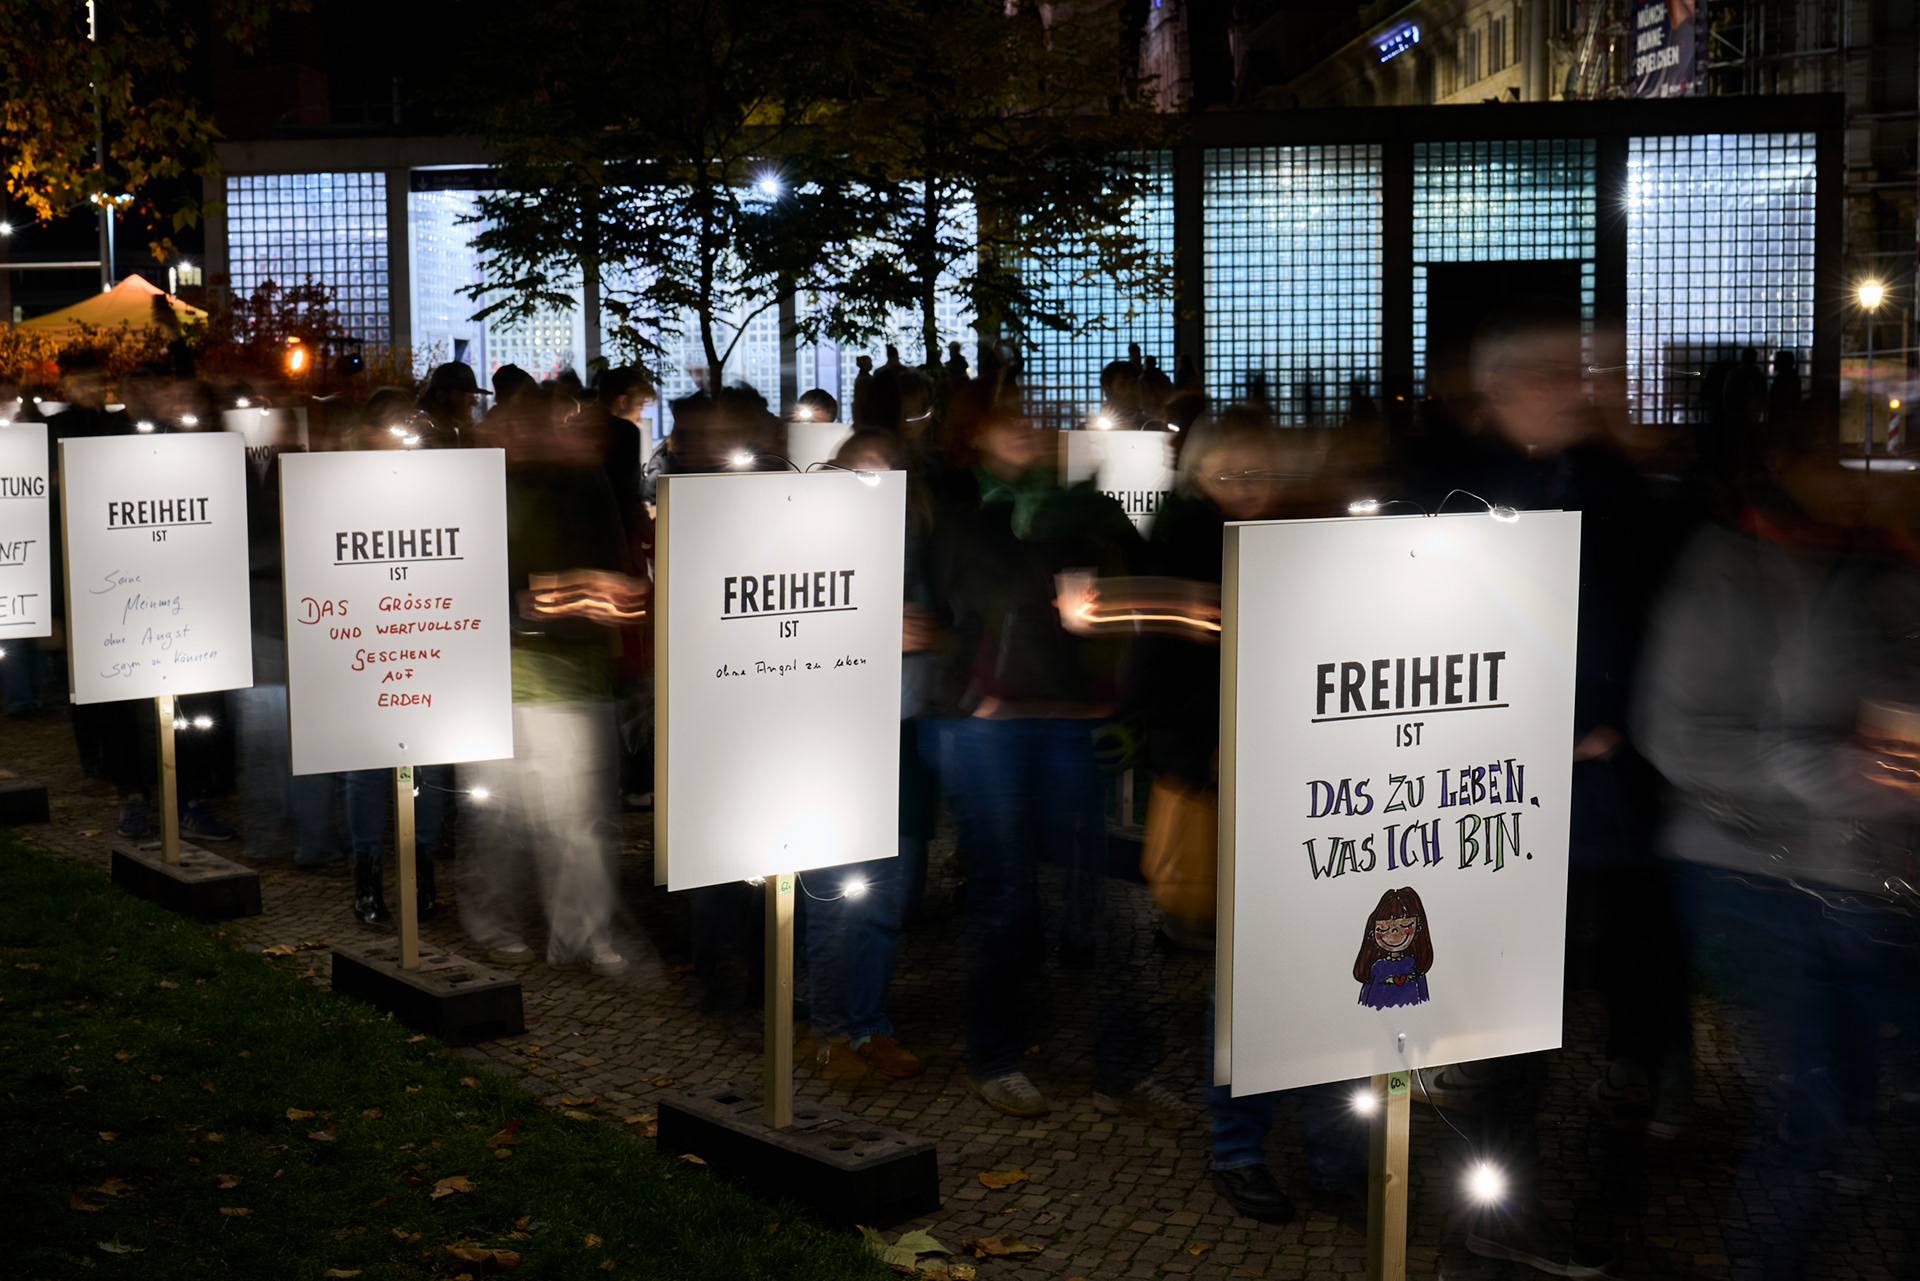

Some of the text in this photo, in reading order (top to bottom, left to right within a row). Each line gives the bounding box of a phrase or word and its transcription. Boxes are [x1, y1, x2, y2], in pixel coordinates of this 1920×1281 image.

[1636, 45, 1680, 77] SPIELCHEN
[108, 497, 209, 526] FREIHEIT
[152, 530, 168, 543] IST
[335, 527, 461, 562] FREIHEIT
[389, 566, 409, 582] IST
[723, 569, 856, 615] FREIHEIT
[297, 597, 350, 625] DAS
[329, 619, 482, 641] UND WERTVOLLSTE
[779, 619, 800, 639] IST
[716, 664, 746, 679] ohne
[1315, 651, 1507, 716] FREIHEIT
[377, 692, 432, 708] ERDEN
[1395, 722, 1425, 748] IST
[1306, 778, 1375, 819] DAS
[1302, 812, 1534, 881] WAS ICH BIN.
